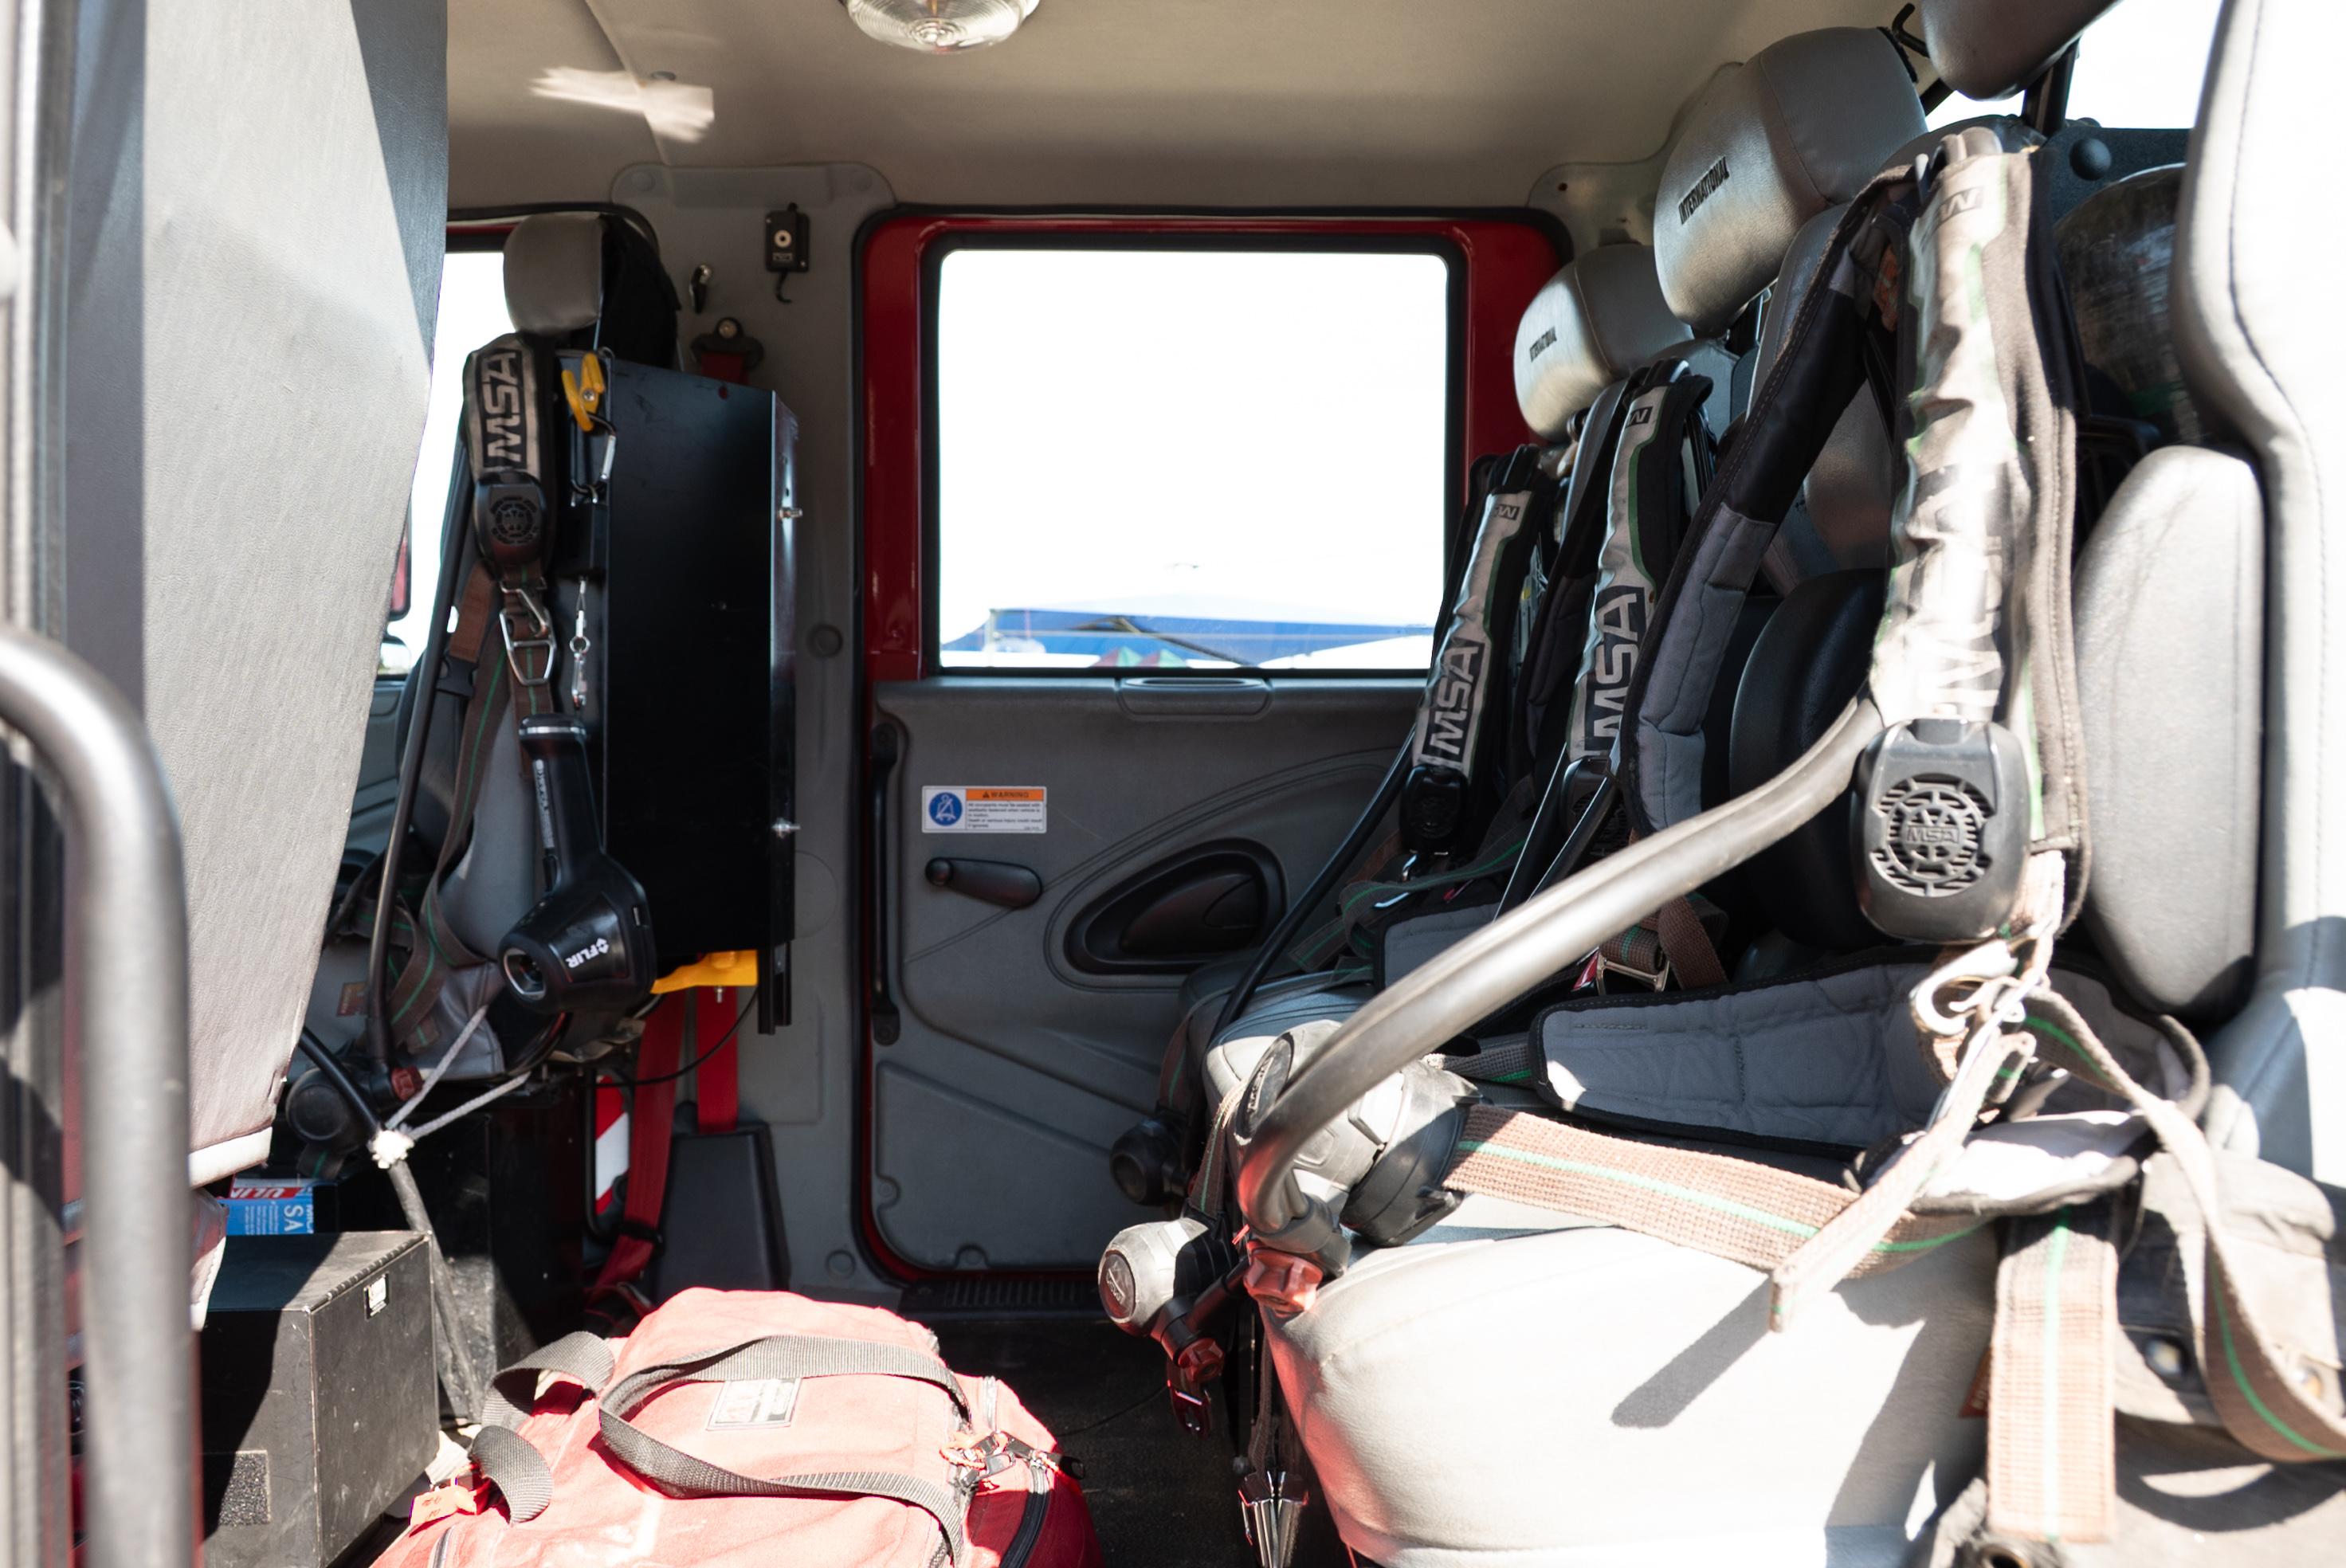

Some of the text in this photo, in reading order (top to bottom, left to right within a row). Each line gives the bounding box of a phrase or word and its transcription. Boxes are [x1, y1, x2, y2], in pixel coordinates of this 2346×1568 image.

[1678, 156, 1729, 224] INTERNATIONAL
[482, 352, 522, 462] MSA
[1430, 645, 1479, 755] MSA
[1594, 593, 1638, 738] MSA
[1907, 826, 1960, 843] MSA
[565, 944, 599, 968] FLIR
